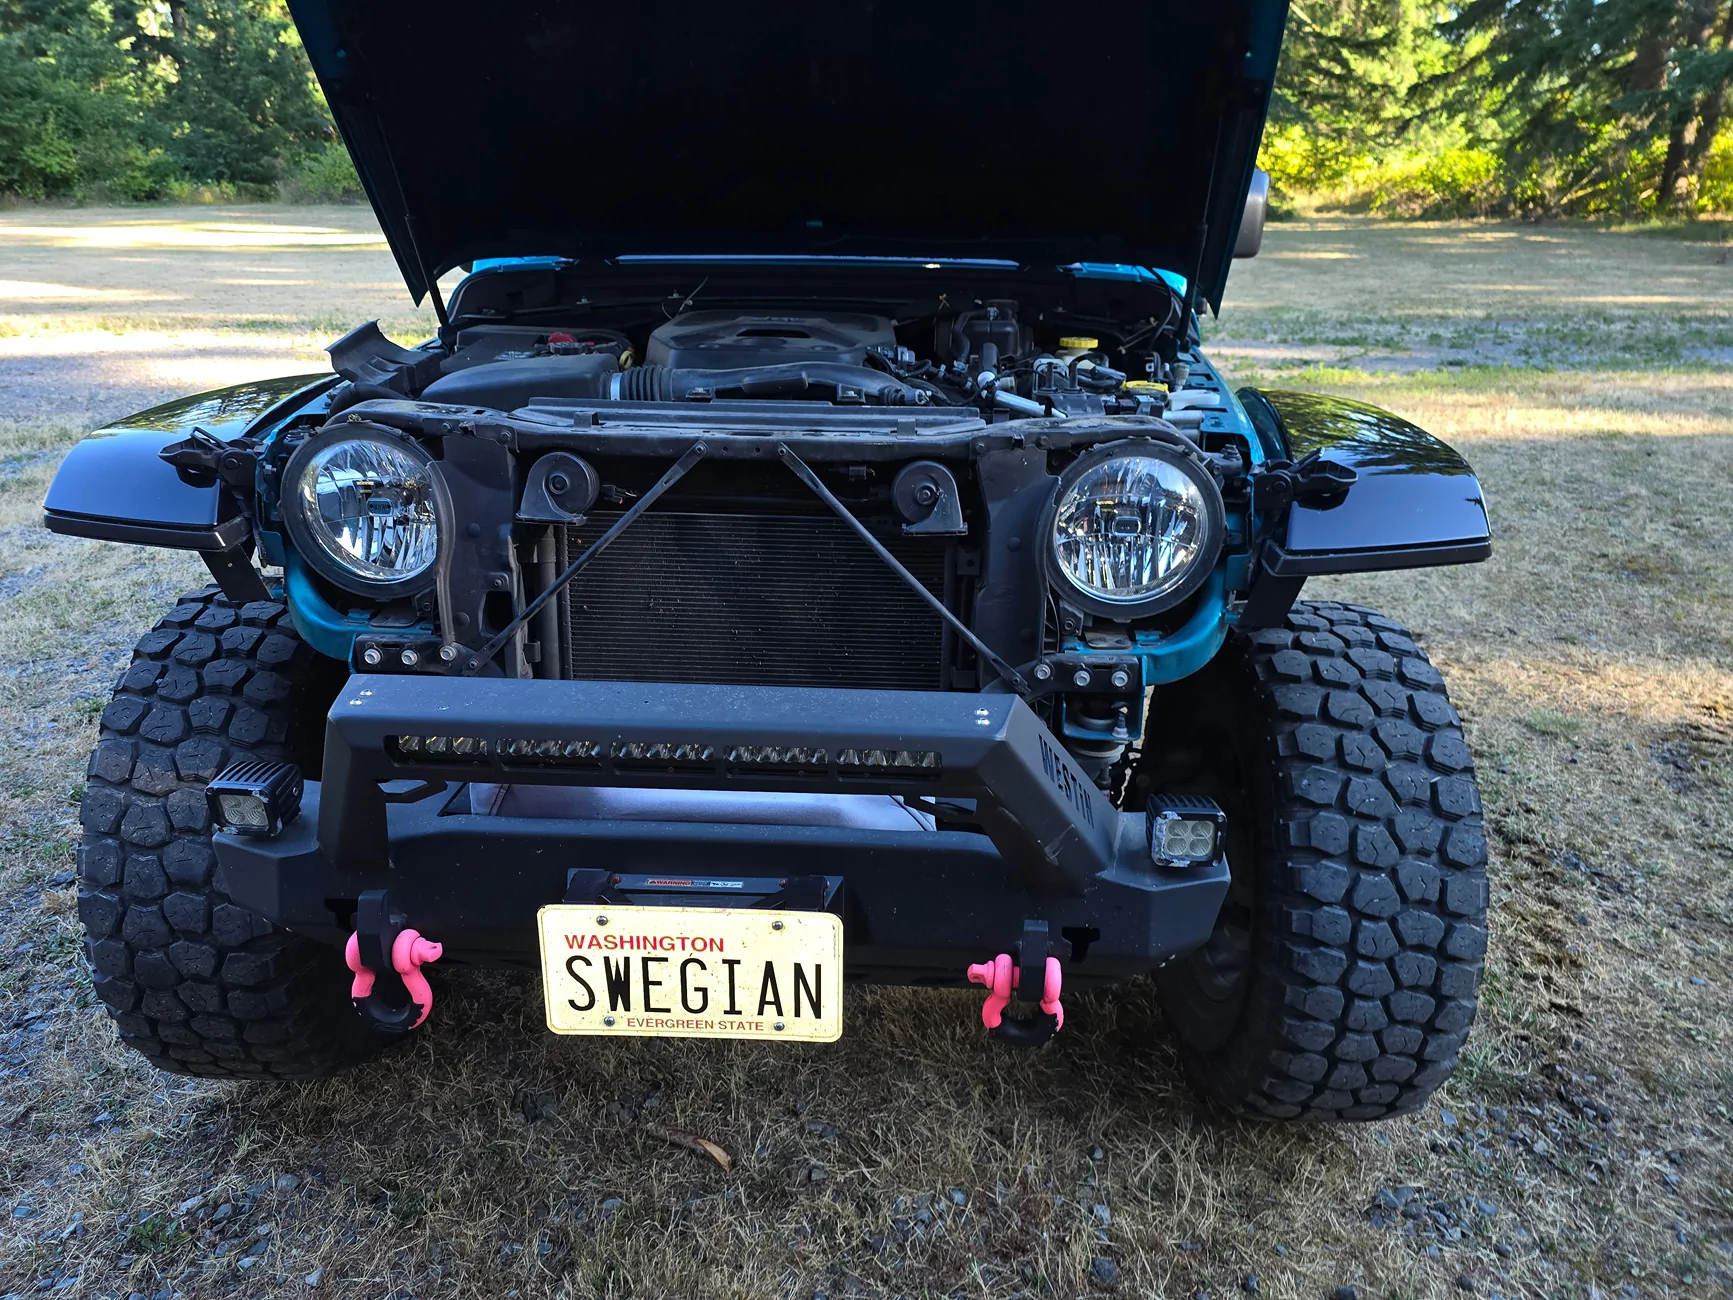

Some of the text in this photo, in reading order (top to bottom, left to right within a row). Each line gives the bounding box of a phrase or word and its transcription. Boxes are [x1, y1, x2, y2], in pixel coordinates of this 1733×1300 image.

[655, 879, 691, 887] WARNING
[564, 934, 724, 953] WASHINGTON
[565, 955, 822, 1020] SWEGIAN
[627, 1017, 764, 1031] EVERGREEN STATE
